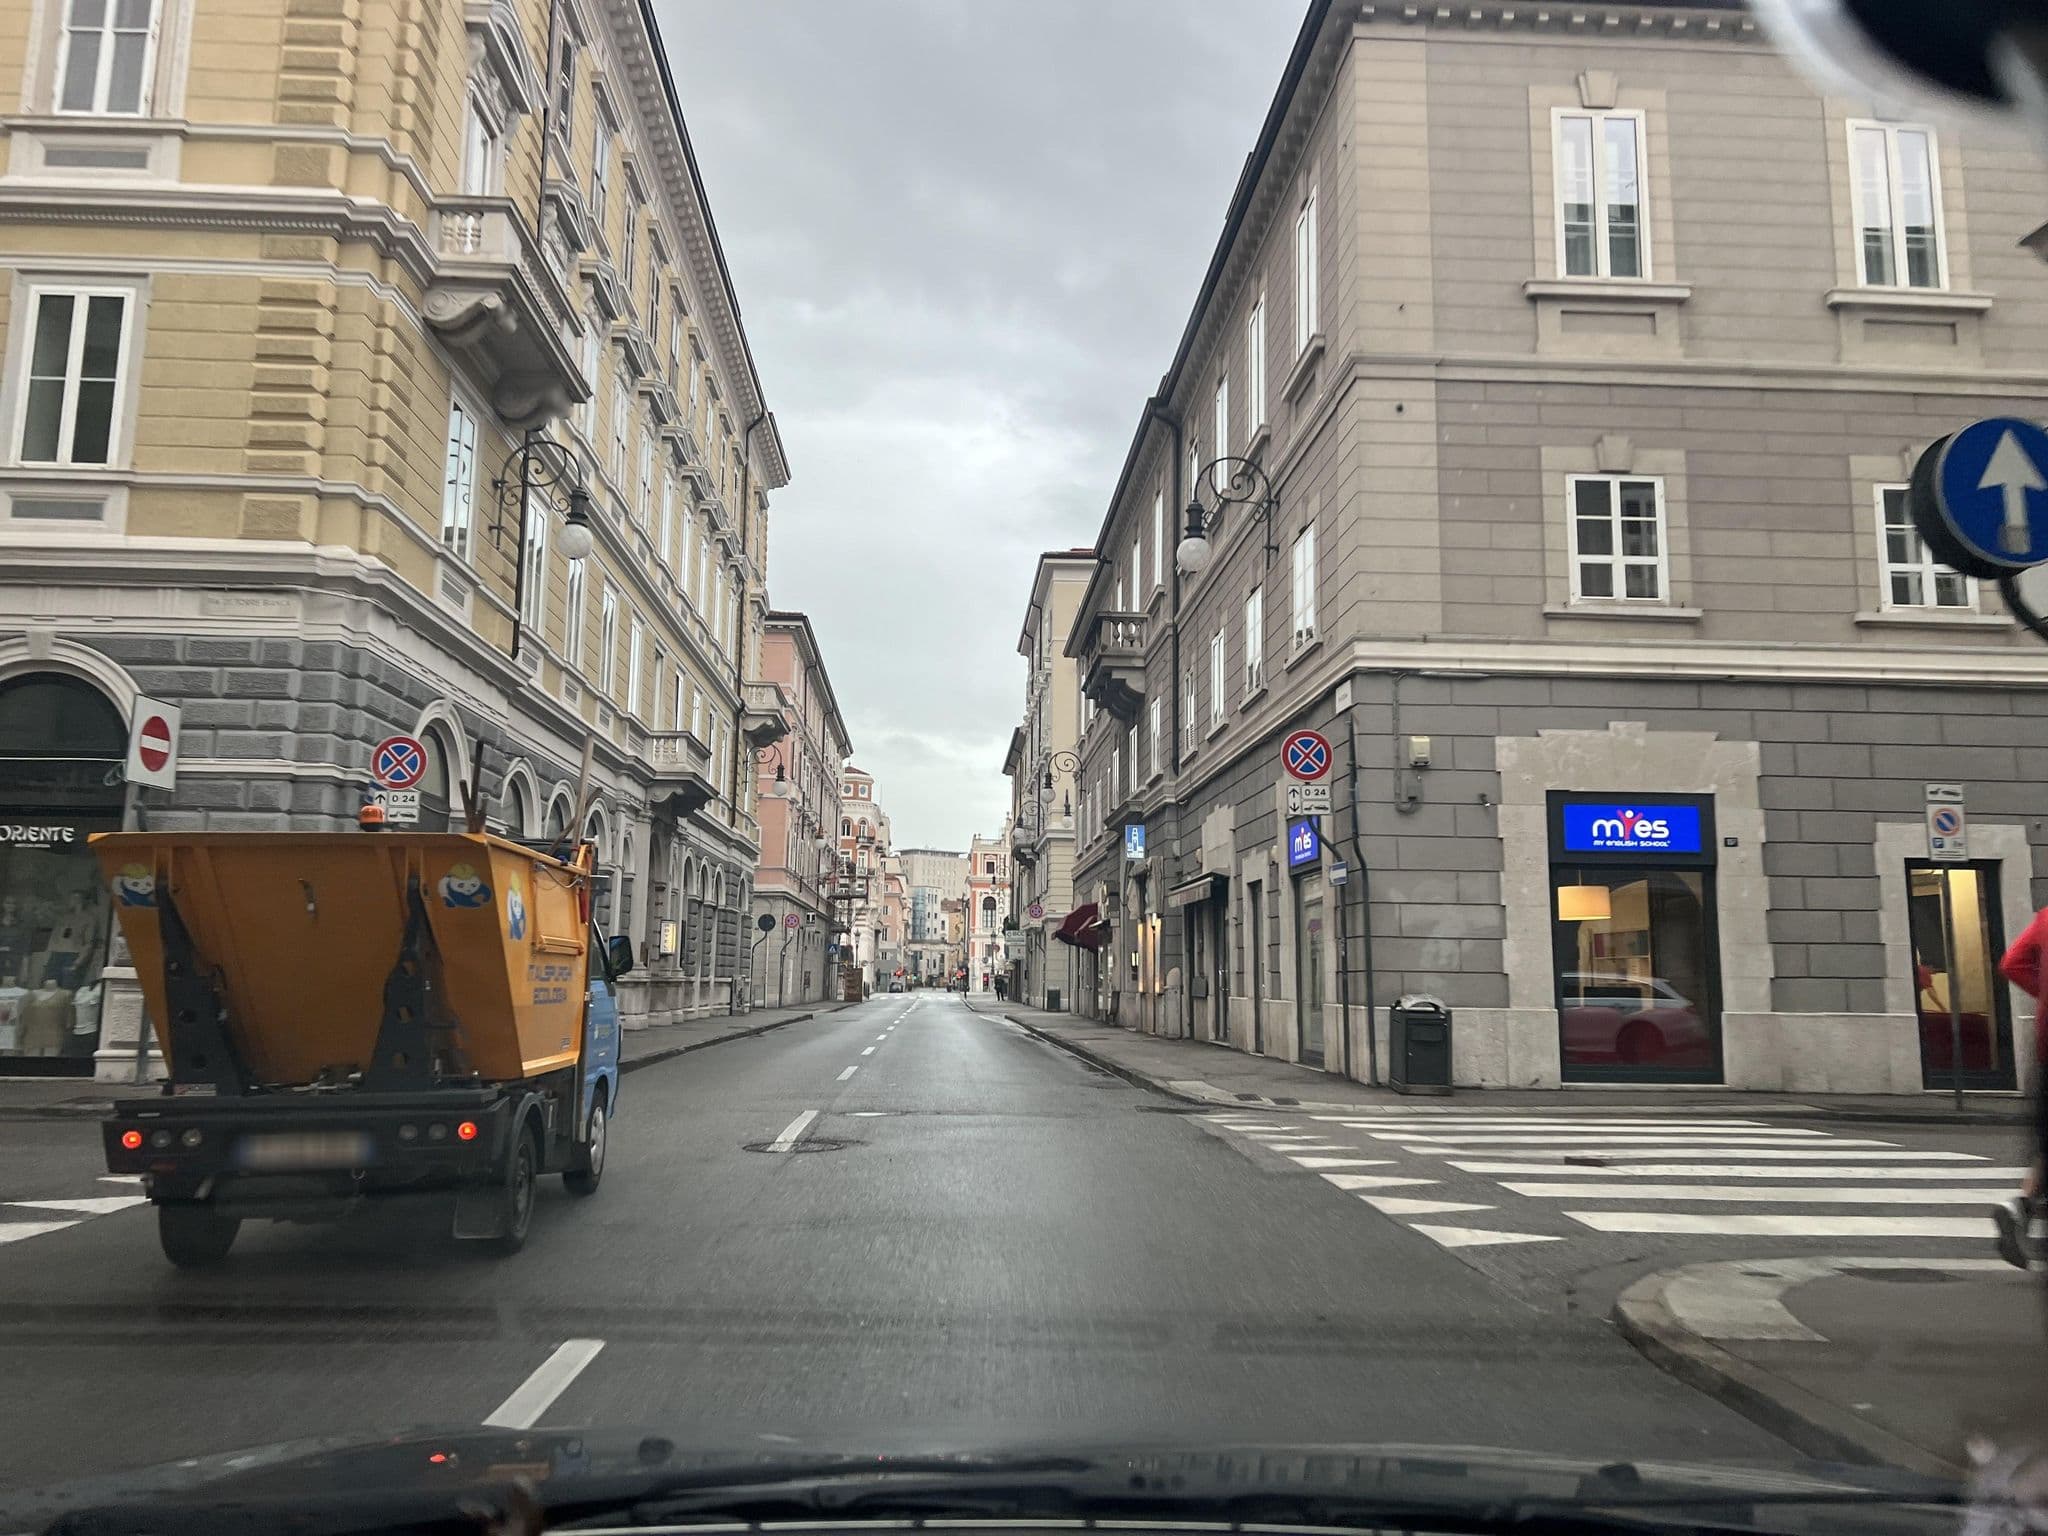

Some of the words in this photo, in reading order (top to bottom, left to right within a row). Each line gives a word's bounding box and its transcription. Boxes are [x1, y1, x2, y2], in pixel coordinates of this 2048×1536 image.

[1304, 788, 1311, 796] 0
[1315, 788, 1326, 796] 24
[392, 795, 399, 803] 0
[402, 795, 415, 803] 24
